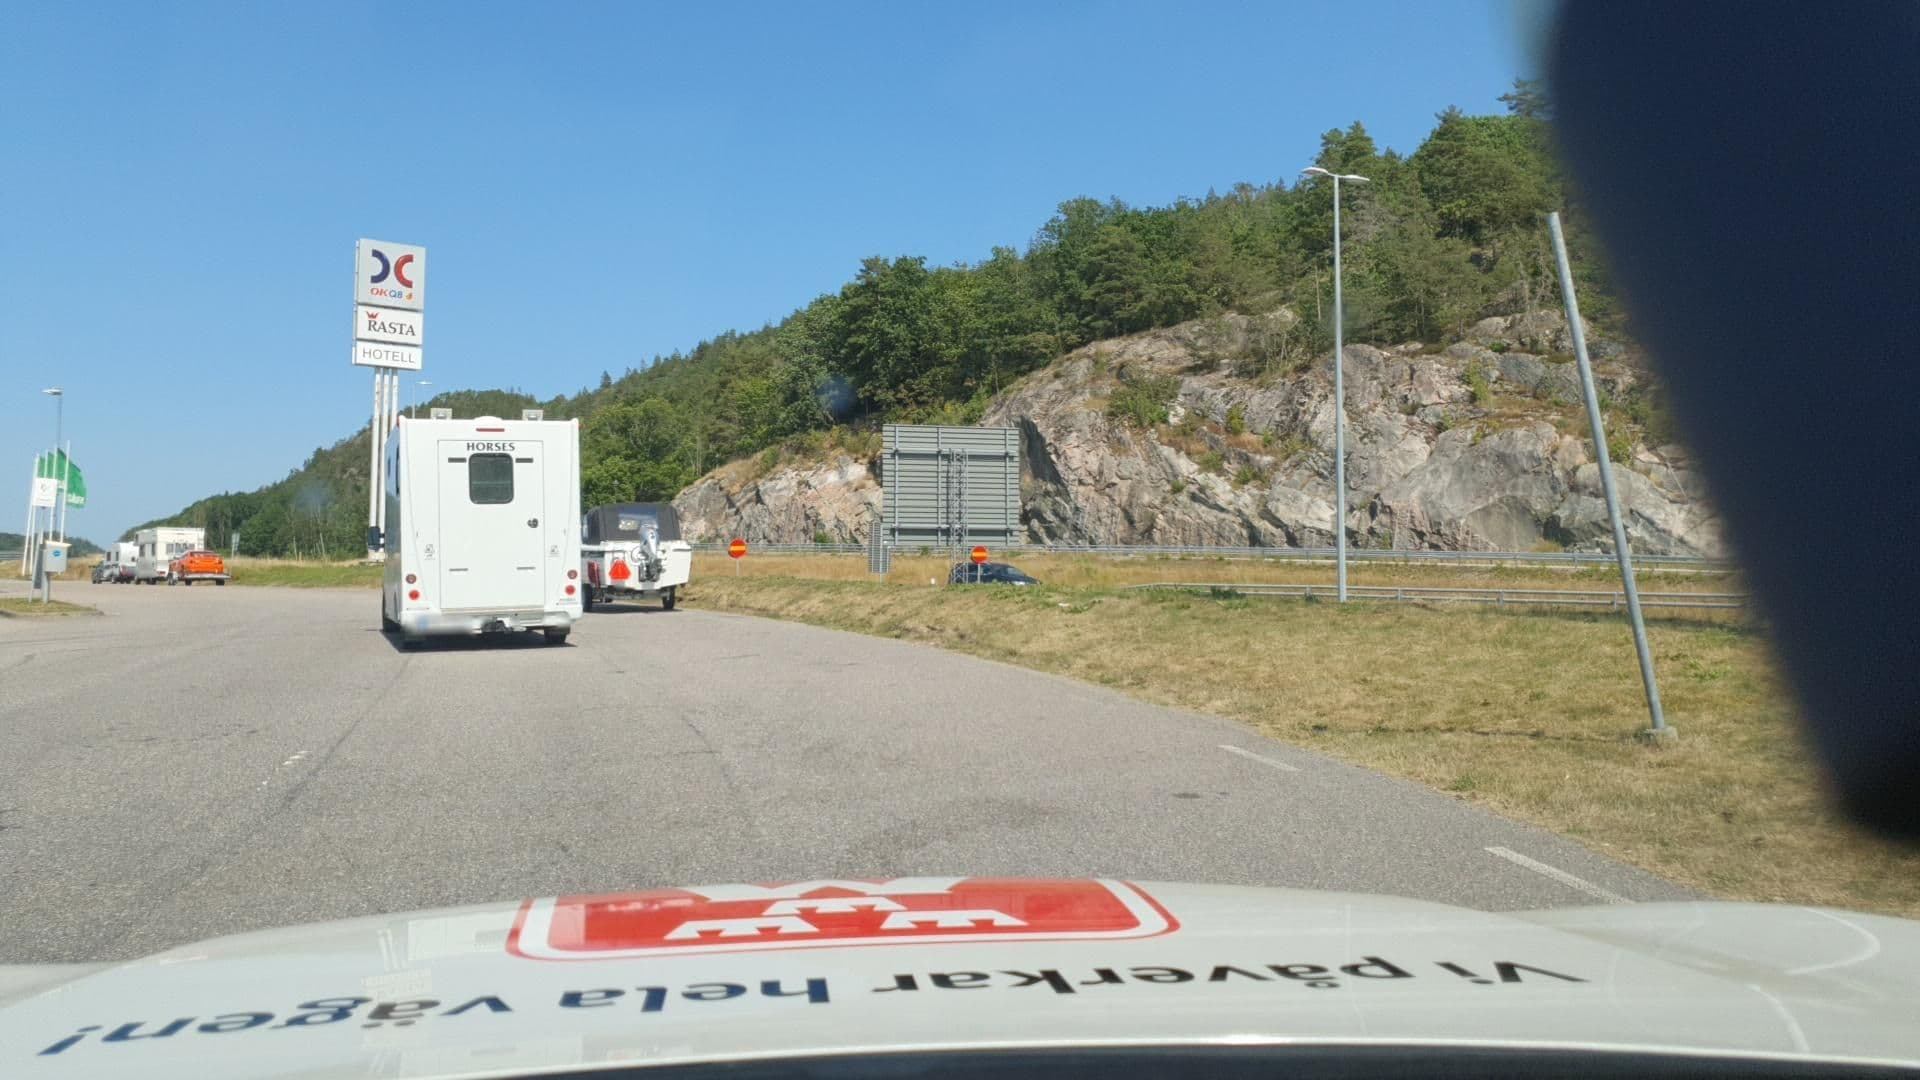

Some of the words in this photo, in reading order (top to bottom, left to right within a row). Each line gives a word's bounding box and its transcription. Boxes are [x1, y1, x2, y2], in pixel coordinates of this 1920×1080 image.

[370, 287, 403, 299] OKQ8
[367, 319, 416, 337] RASTA
[362, 347, 415, 363] HOTELL
[466, 442, 515, 451] HORSES
[872, 956, 1417, 994] påverkar
[1434, 961, 1591, 986] Vi
[558, 977, 831, 1013] hela
[37, 996, 513, 1057] vägen!
